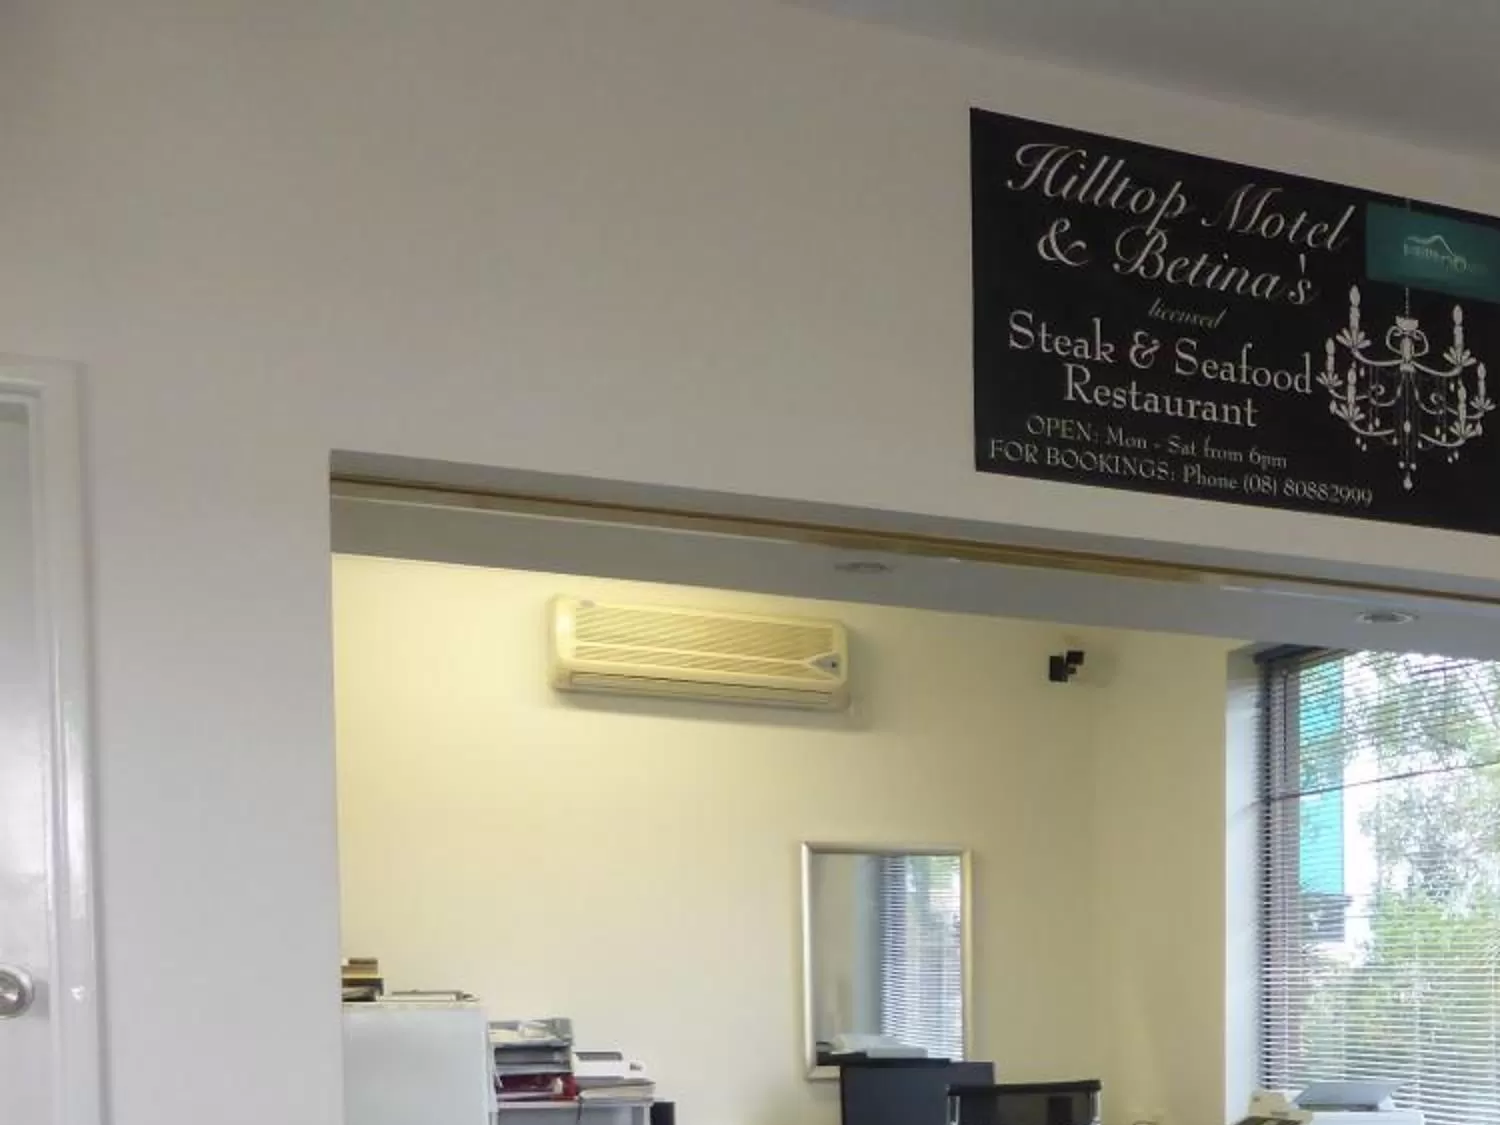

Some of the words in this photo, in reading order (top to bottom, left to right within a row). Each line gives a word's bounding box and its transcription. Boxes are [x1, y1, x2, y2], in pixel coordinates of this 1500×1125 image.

[1006, 143, 1187, 235] Hilltop
[1200, 183, 1356, 252] Motel
[1037, 217, 1088, 267] &
[1112, 225, 1312, 305] Betina's
[1148, 298, 1229, 329] licensed
[1008, 309, 1117, 365] Steak
[1128, 330, 1161, 369] &
[1174, 336, 1313, 395] Seafood
[1063, 362, 1259, 428] Restaurant
[989, 437, 1038, 466] FOR
[1046, 446, 1176, 482] BOOKINGS:
[1182, 462, 1241, 490] Phone
[1242, 473, 1278, 497] (08)
[1025, 414, 1100, 444] OPEN:
[1105, 424, 1148, 450] Mon
[1167, 433, 1197, 457] Sat
[1203, 435, 1244, 463] from
[1249, 446, 1289, 472] 6pm
